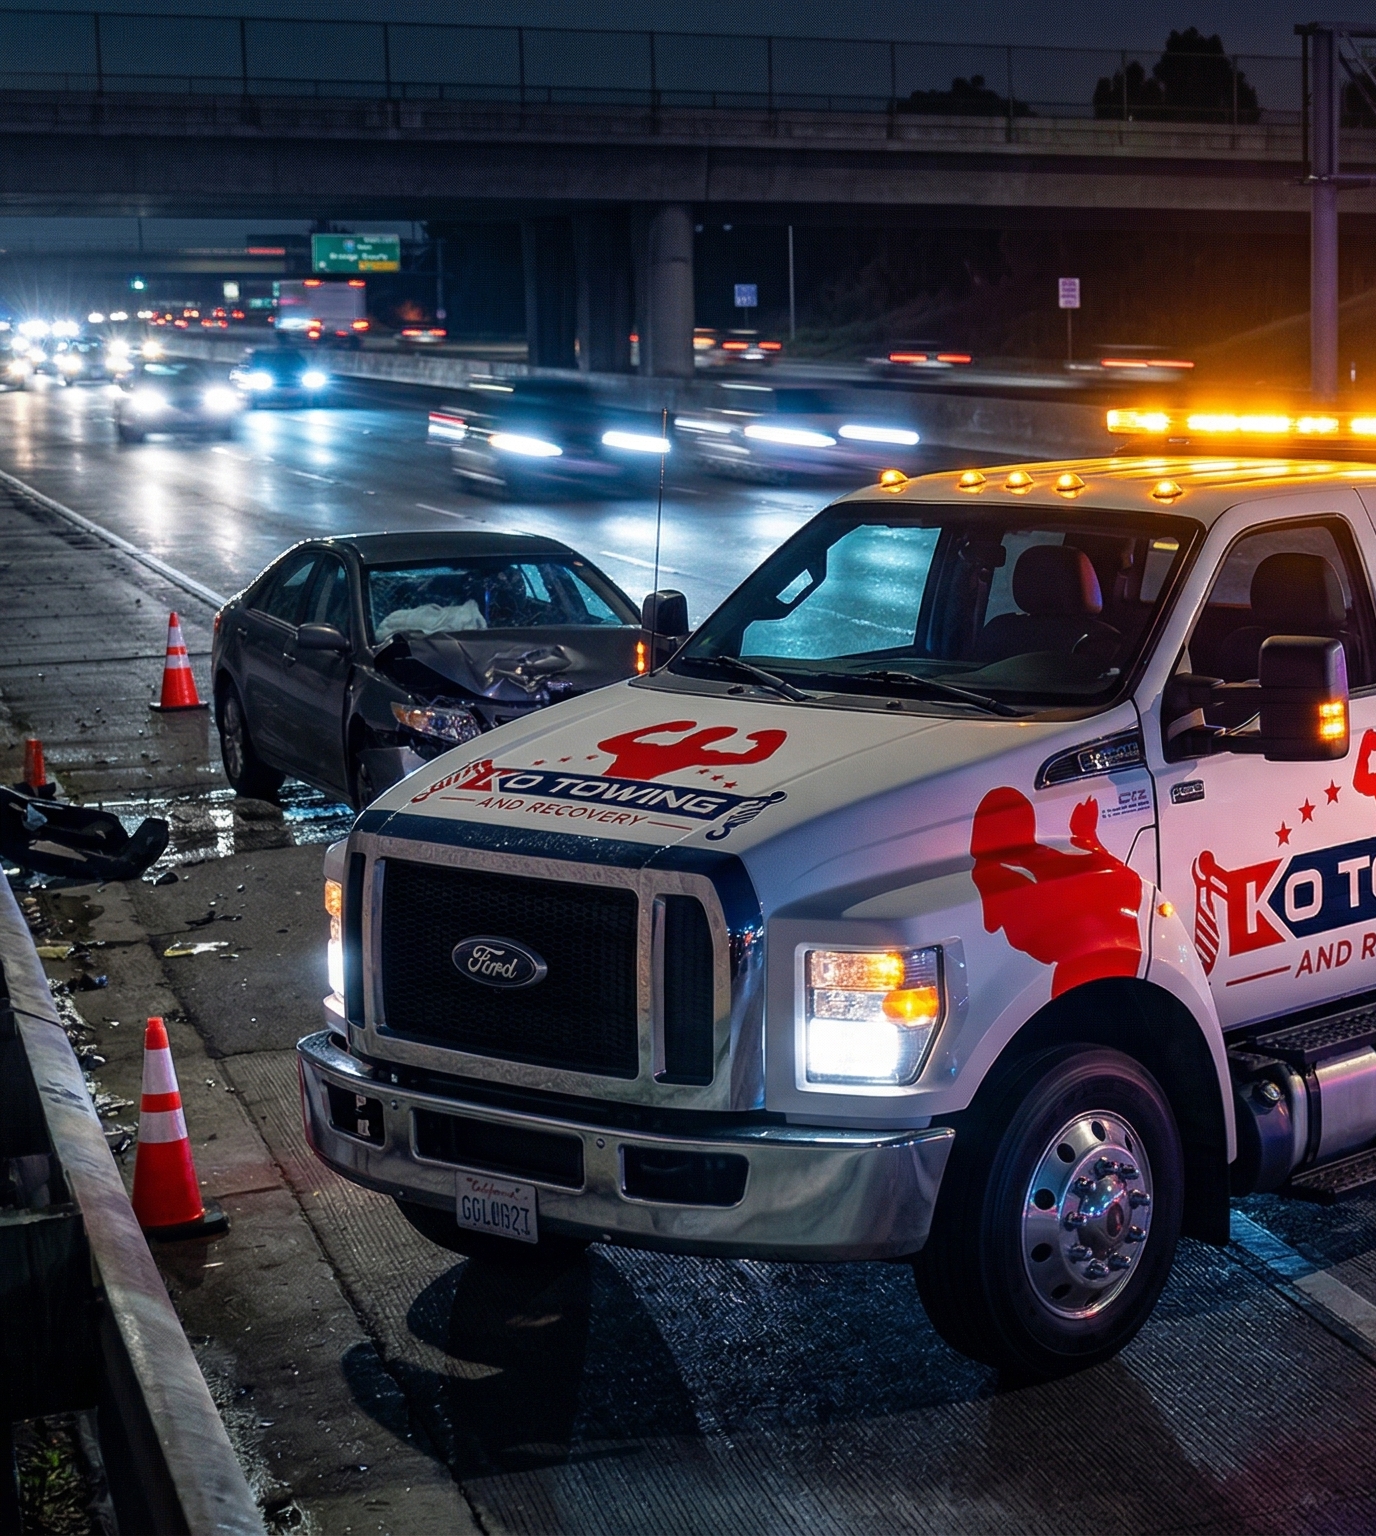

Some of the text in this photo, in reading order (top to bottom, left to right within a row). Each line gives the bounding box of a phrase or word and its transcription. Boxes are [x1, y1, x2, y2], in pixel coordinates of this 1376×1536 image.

[474, 770, 728, 814] KO TOWING
[475, 796, 648, 827] AND RECOVERY
[1245, 857, 1323, 936] KO
[467, 945, 518, 979] Ford
[1295, 940, 1352, 978] AND
